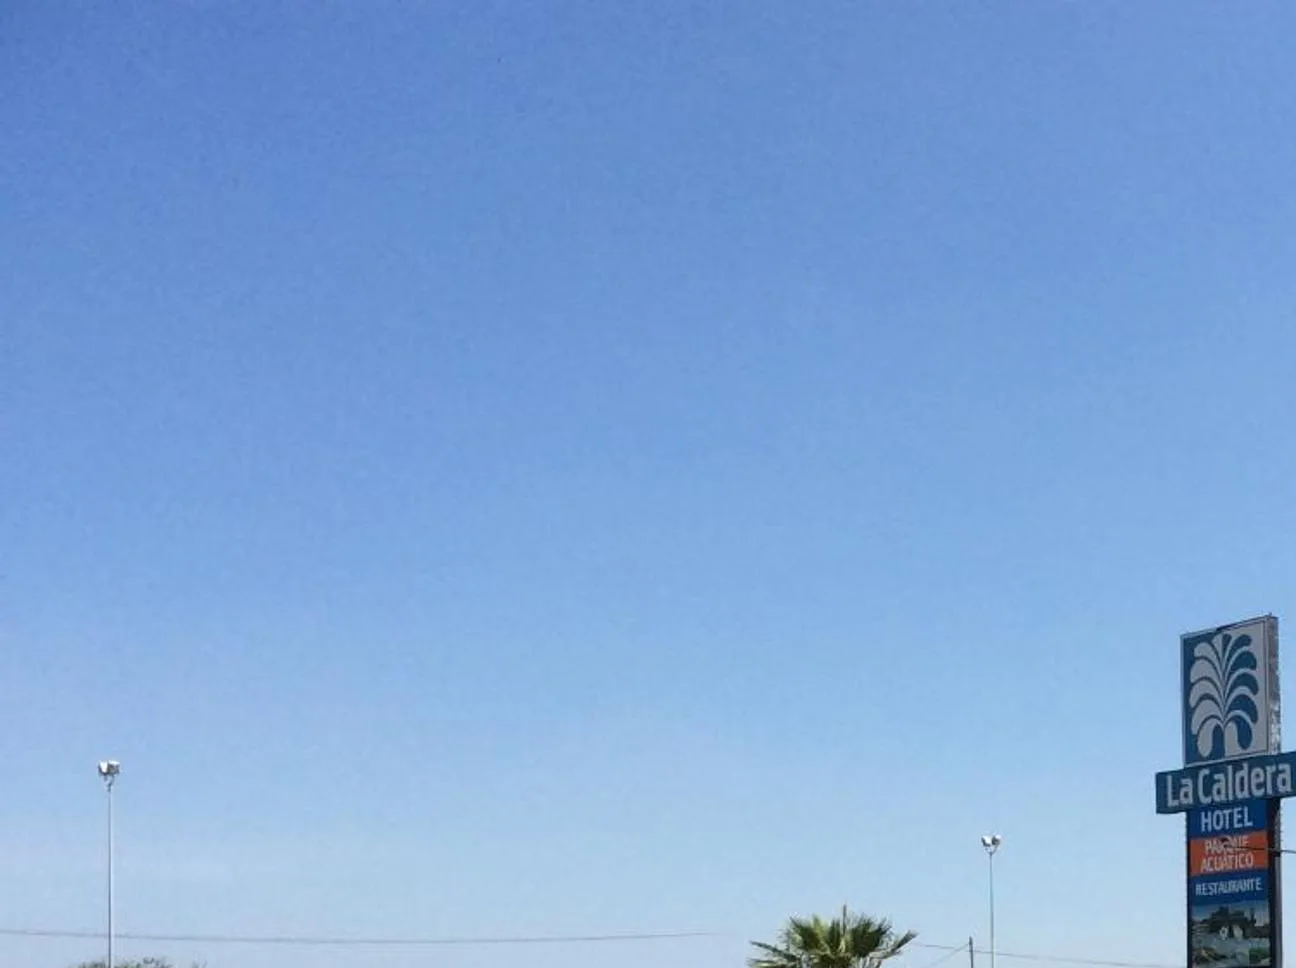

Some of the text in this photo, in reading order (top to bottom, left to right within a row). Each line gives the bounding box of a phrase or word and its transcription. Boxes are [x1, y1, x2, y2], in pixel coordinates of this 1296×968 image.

[1166, 763, 1292, 807] La Caldera
[1201, 806, 1253, 832] HOTEL
[1195, 877, 1263, 896] RESTAURANTE
